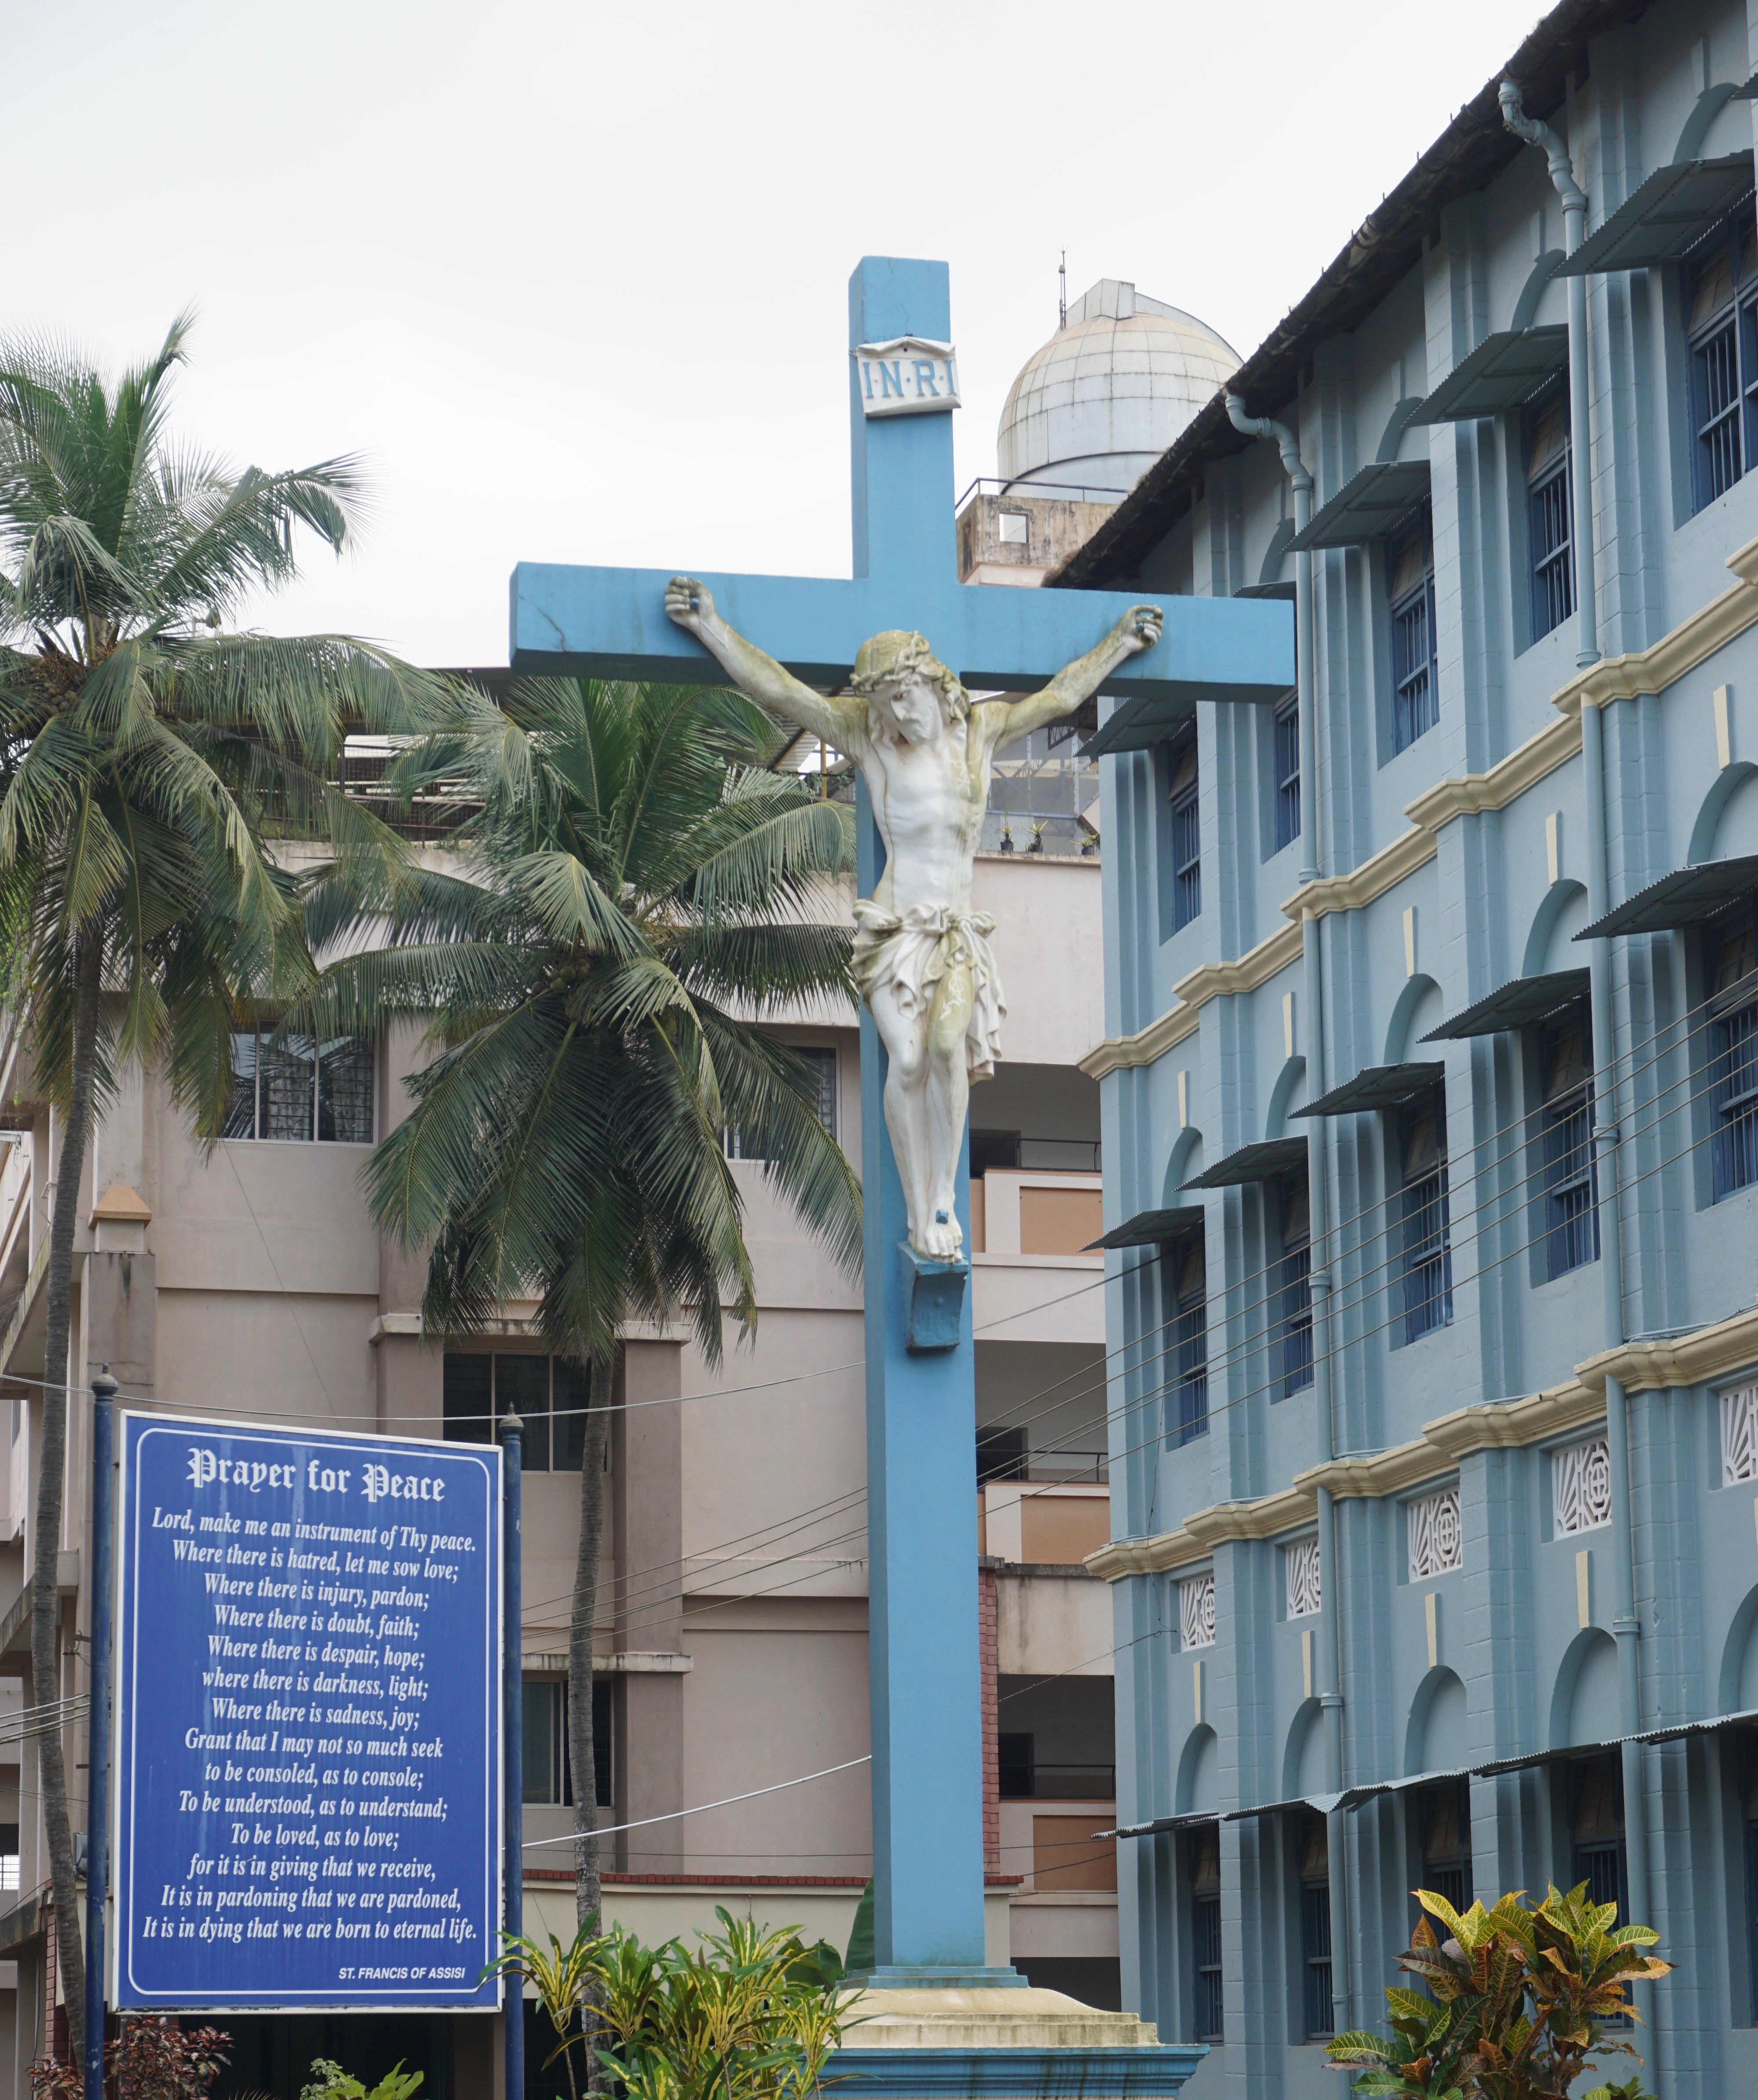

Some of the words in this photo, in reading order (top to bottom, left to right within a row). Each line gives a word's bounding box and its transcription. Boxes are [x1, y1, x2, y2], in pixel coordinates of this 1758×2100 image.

[185, 1447, 296, 1493] Prayer
[307, 1459, 351, 1494] for
[360, 1463, 445, 1503] Peace
[151, 1507, 195, 1534] Lord,
[199, 1512, 241, 1534] make
[244, 1520, 268, 1536] me
[271, 1522, 291, 1538] an
[295, 1518, 378, 1544] instrument
[380, 1525, 398, 1550] of
[400, 1527, 428, 1552] Thy
[429, 1534, 476, 1554] peace.
[172, 1539, 223, 1563] Where
[226, 1544, 267, 1566] there
[270, 1547, 283, 1567] is
[287, 1548, 341, 1576] hatred,
[345, 1552, 365, 1573] let
[367, 1560, 389, 1575] me
[392, 1561, 420, 1577] sow
[424, 1557, 459, 1584] love;
[204, 1573, 254, 1596] Where
[257, 1576, 298, 1599] there
[301, 1579, 314, 1600] is
[318, 1581, 367, 1608] injury,
[369, 1586, 429, 1612] pardon;
[214, 1604, 264, 1628] Where
[267, 1607, 307, 1630] there
[311, 1610, 324, 1631] is
[327, 1611, 374, 1638] doubt,
[376, 1614, 419, 1641] faith;
[207, 1635, 258, 1658] Where
[261, 1638, 301, 1661] there
[305, 1640, 318, 1661] is
[321, 1641, 379, 1669] despair,
[383, 1645, 425, 1672] hope;
[202, 1666, 249, 1689] where
[253, 1668, 293, 1690] there
[297, 1671, 309, 1691] is
[313, 1671, 384, 1699] darkness,
[389, 1675, 429, 1701] light;
[212, 1697, 262, 1720] Where
[265, 1700, 305, 1722] there
[309, 1702, 322, 1723] is
[326, 1703, 387, 1730] sadness,
[389, 1706, 420, 1732] joy;
[185, 1727, 232, 1750] Grant
[235, 1729, 267, 1751] that
[269, 1731, 279, 1752] I
[282, 1737, 314, 1758] may
[317, 1736, 343, 1754] not
[345, 1740, 363, 1755] so
[366, 1736, 407, 1756] much
[411, 1737, 443, 1758] seek
[205, 1762, 220, 1781] to
[224, 1760, 243, 1781] be
[247, 1762, 318, 1788] consoled,
[322, 1770, 339, 1784] as
[343, 1767, 358, 1785] to
[362, 1766, 423, 1792] console;
[179, 1790, 198, 1811] To
[202, 1791, 221, 1812] be
[225, 1792, 315, 1819] understood,
[319, 1800, 336, 1815] as
[340, 1797, 355, 1816] to
[359, 1795, 447, 1822] understand;
[231, 1823, 250, 1844] To
[253, 1823, 272, 1844] be
[276, 1824, 320, 1850] loved,
[324, 1831, 341, 1846] as
[345, 1828, 360, 1846] to
[363, 1825, 399, 1851] love;
[186, 1853, 214, 1880] for
[218, 1854, 230, 1875] it
[233, 1854, 246, 1875] is
[250, 1854, 266, 1875] in
[269, 1855, 319, 1882] giving
[322, 1855, 353, 1877] that
[356, 1862, 376, 1877] we
[380, 1857, 436, 1882] receive,
[160, 1885, 175, 1906] It
[179, 1885, 192, 1906] is
[196, 1885, 212, 1906] in
[215, 1885, 298, 1912] pardoning
[301, 1886, 333, 1908] that
[336, 1893, 356, 1908] we
[360, 1893, 385, 1908] are
[386, 1887, 461, 1913] pardoned,
[142, 1916, 157, 1937] It
[161, 1916, 174, 1938] is
[178, 1916, 195, 1938] in
[199, 1916, 243, 1943] dying
[247, 1917, 279, 1938] that
[282, 1923, 302, 1938] we
[306, 1923, 331, 1938] are
[335, 1917, 370, 1938] born
[374, 1920, 389, 1938] to
[393, 1918, 446, 1939] eternal
[449, 1918, 476, 1944] life.
[338, 1967, 355, 1979] ST.
[358, 1967, 408, 1979] FRANCIS
[410, 1967, 427, 1979] OF
[428, 1967, 465, 1979] ASSISI
